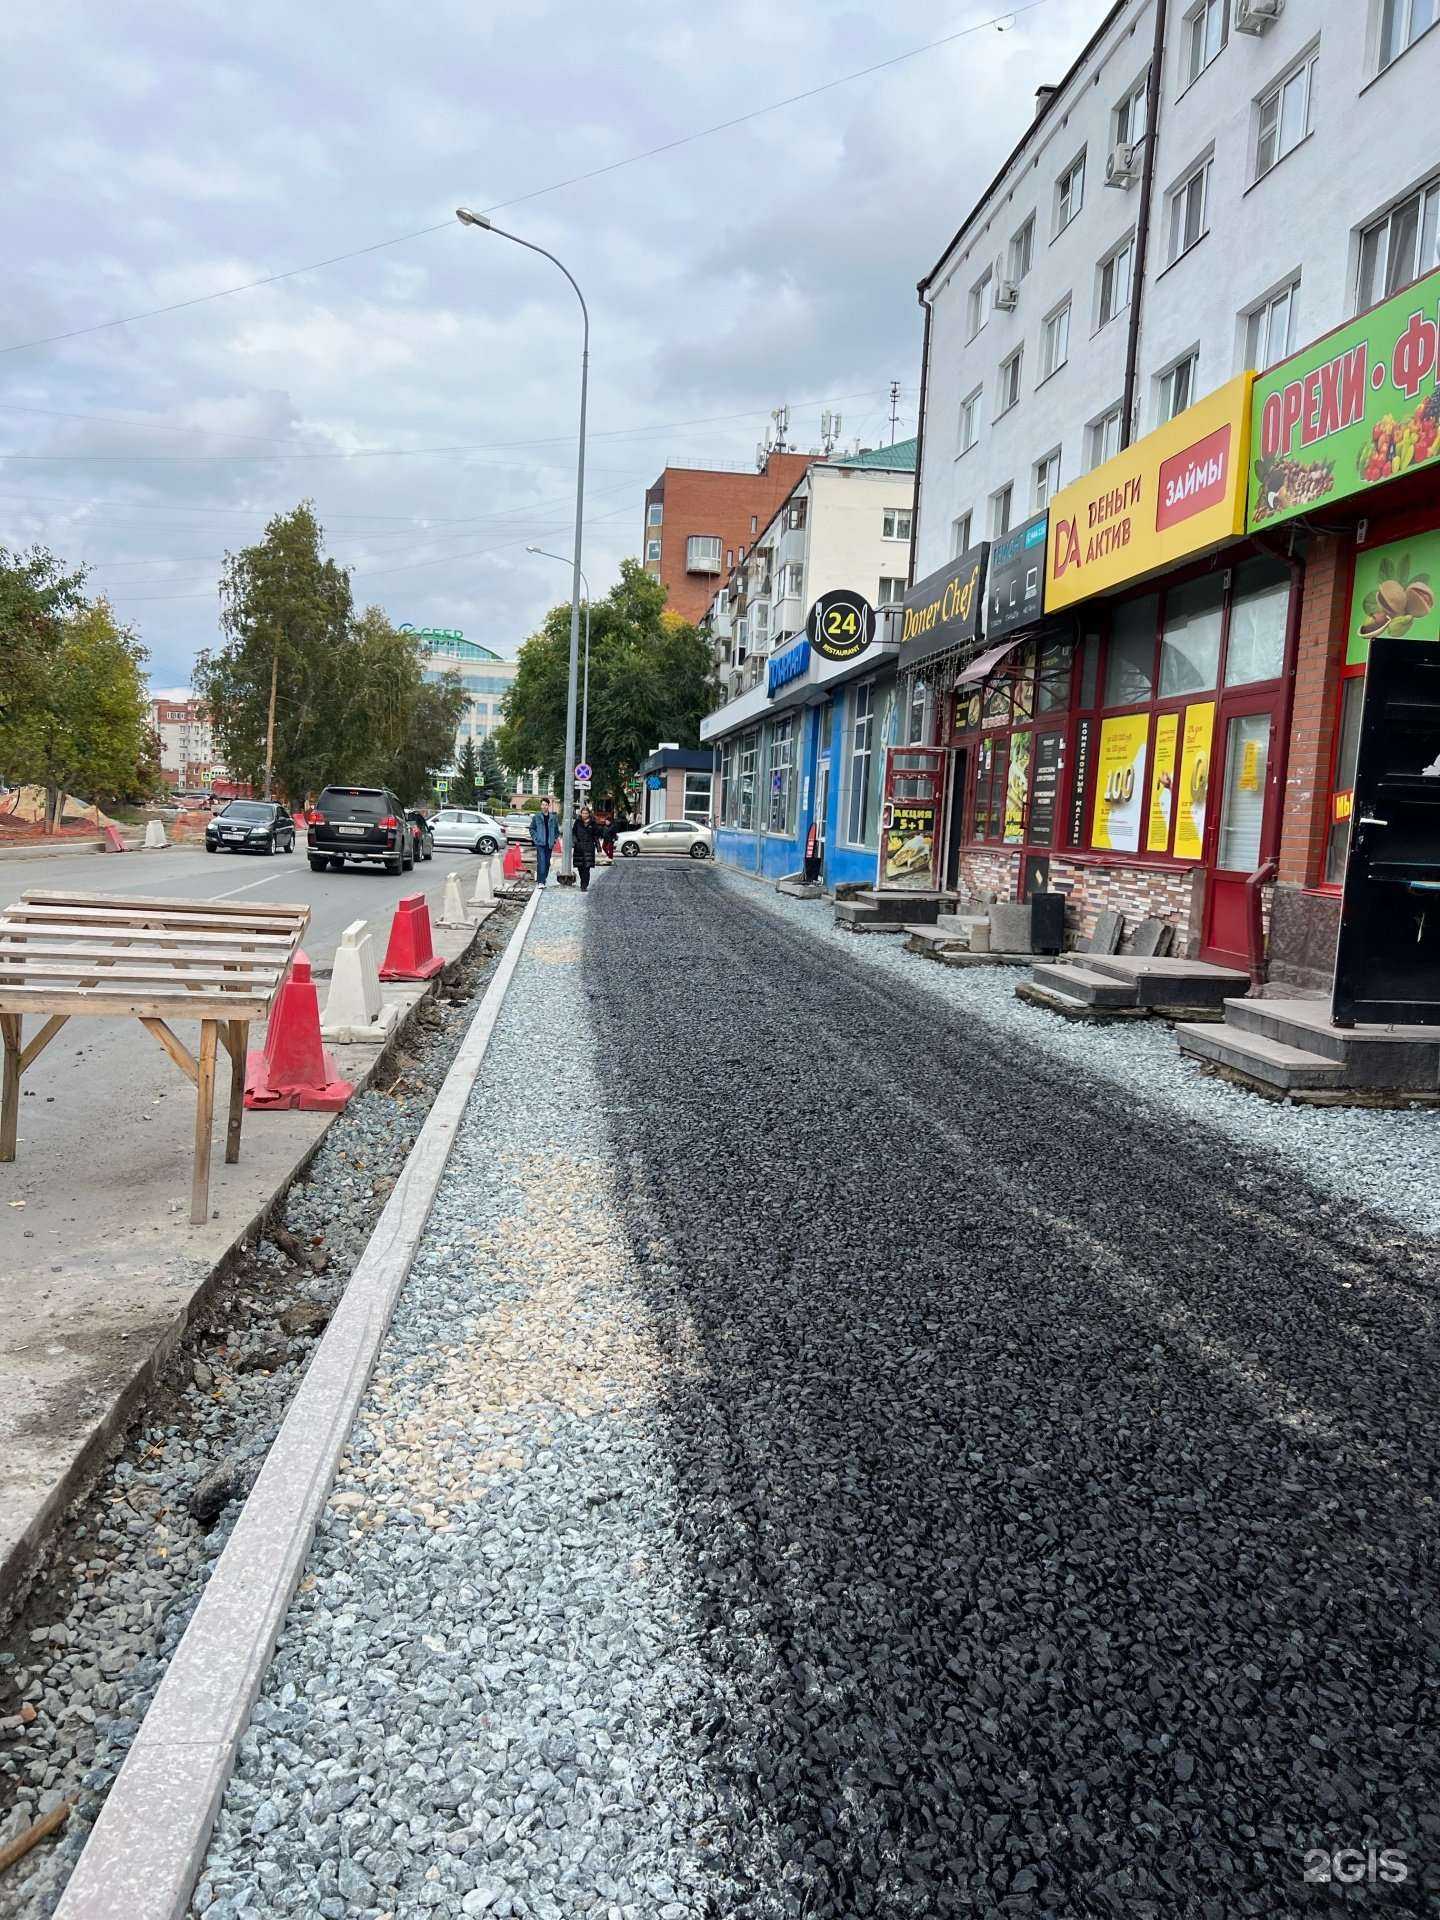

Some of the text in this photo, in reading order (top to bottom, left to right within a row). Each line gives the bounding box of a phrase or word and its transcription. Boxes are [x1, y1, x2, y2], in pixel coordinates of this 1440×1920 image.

[1261, 298, 1440, 460] ОРЕХИ Ф
[1165, 452, 1224, 507] ЗАЙМЫ
[1085, 517, 1131, 564] АКТИВ
[827, 611, 857, 635] 24
[902, 599, 941, 642] Doner
[942, 565, 979, 622] Chef
[822, 643, 860, 656] RESTAURANT
[894, 809, 933, 819] АКЦИЯ
[899, 819, 925, 830] 5+1
[1072, 800, 1083, 844] МАГАЗИН
